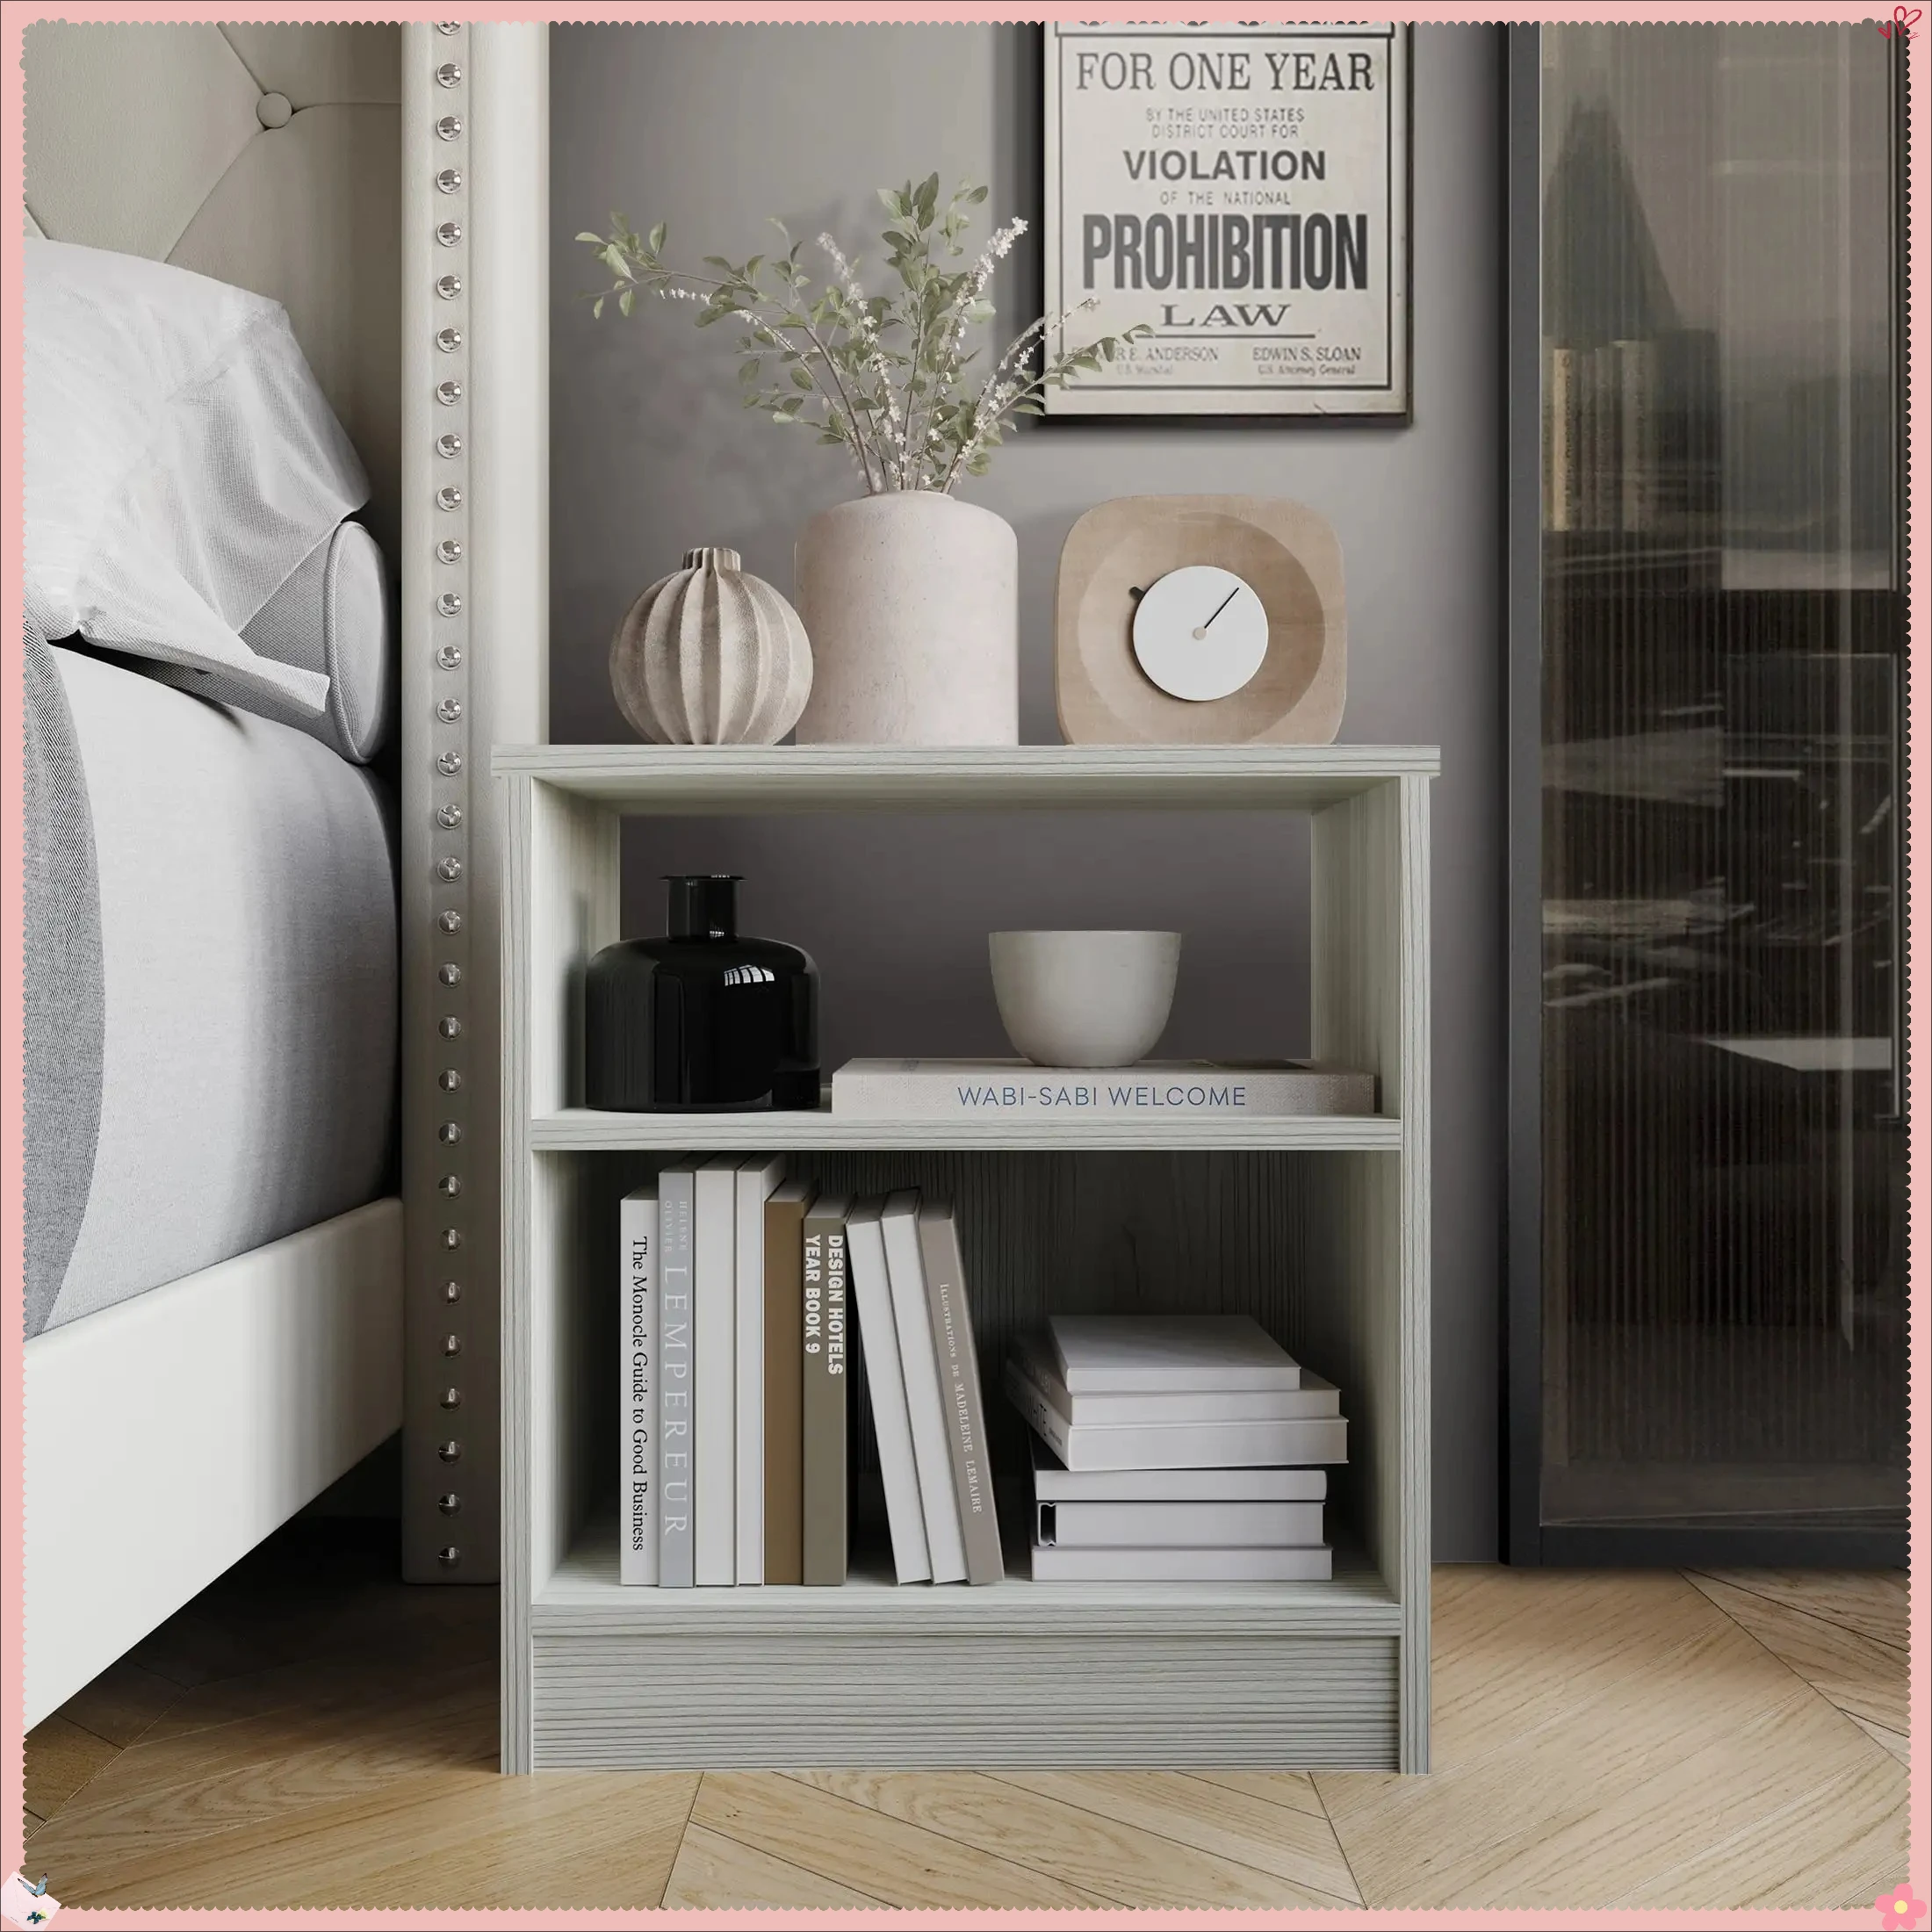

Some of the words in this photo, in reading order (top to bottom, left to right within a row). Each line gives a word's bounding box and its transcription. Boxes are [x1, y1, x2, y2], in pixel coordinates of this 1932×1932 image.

[1076, 52, 1157, 90] FOR
[1169, 52, 1251, 90] ONE
[1265, 52, 1375, 90] YEAR
[1146, 108, 1161, 122] BY
[1168, 108, 1193, 122] THE
[1199, 108, 1249, 122] UNITED
[1254, 108, 1305, 122] STATES
[1152, 125, 1213, 138] DISTRICT
[1220, 125, 1265, 138] COURT
[1272, 125, 1299, 138] FOR
[1122, 150, 1325, 181] VIOLATION
[1160, 191, 1178, 205] OF
[1188, 191, 1213, 205] THE
[1224, 191, 1291, 205] NATIONAL
[1083, 213, 1368, 290] PROHIBITION
[1160, 304, 1292, 327] LAW
[1146, 347, 1219, 361] ANDERSON
[1252, 347, 1297, 361] EDWIN
[1316, 347, 1360, 361] SLOAN
[958, 1087, 1097, 1106] WABI-SABI
[1108, 1087, 1246, 1106] WELCOME
[633, 1236, 647, 1270] The
[805, 1235, 821, 1282] YEAR
[828, 1235, 844, 1302] DESIGN
[633, 1276, 647, 1347] Monocle
[805, 1288, 821, 1337] BOOK
[805, 1343, 820, 1354] 9
[828, 1308, 844, 1375] HOTELS
[633, 1352, 648, 1402] Guide
[633, 1409, 645, 1424] to
[664, 1265, 688, 1536] LEMPEREUR
[633, 1429, 648, 1474] Good
[955, 1383, 973, 1453] MADELEINE
[966, 1460, 982, 1513] LEMAIRE
[633, 1481, 648, 1551] Business
